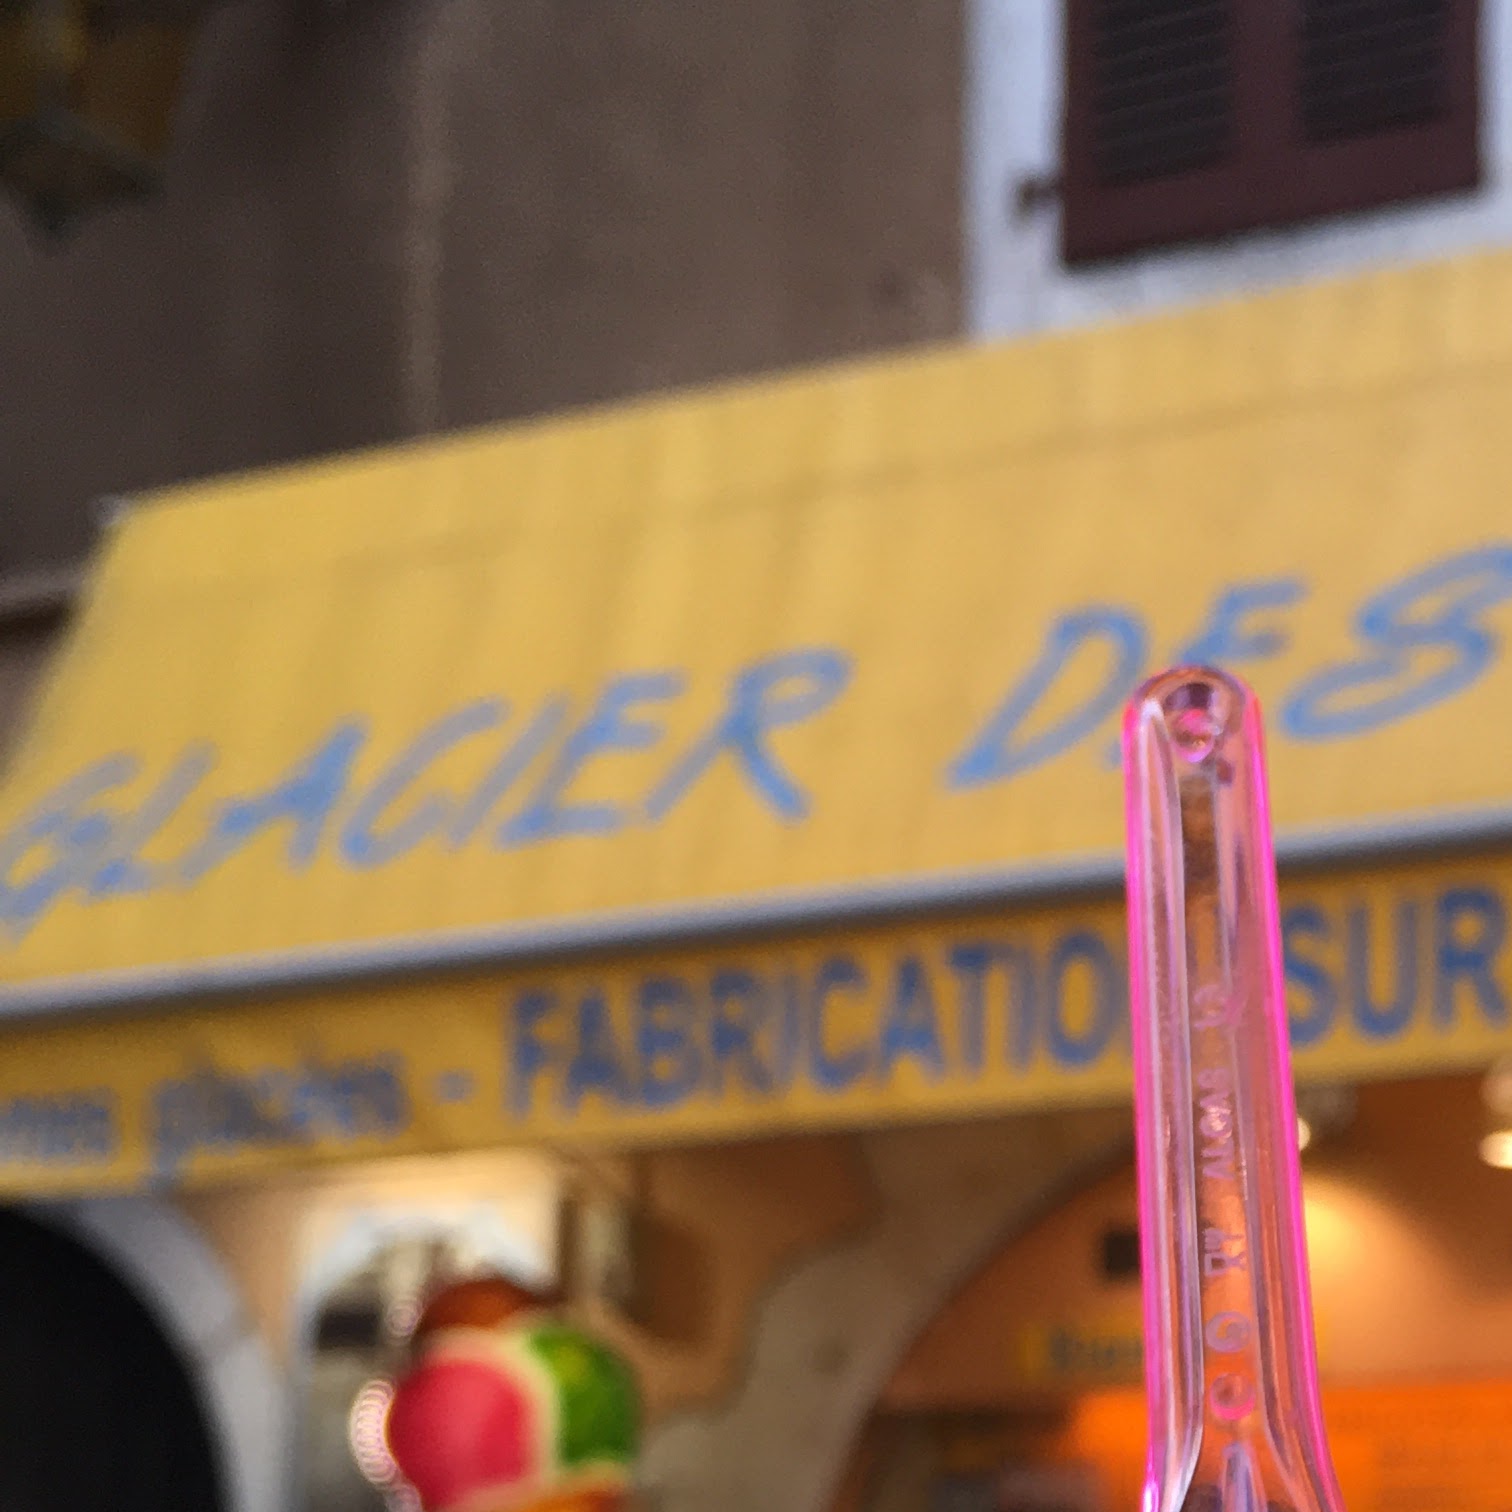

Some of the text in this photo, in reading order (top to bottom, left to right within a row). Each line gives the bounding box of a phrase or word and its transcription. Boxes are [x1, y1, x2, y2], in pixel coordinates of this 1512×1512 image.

[0, 646, 856, 945] GLACIER
[504, 924, 1130, 1124] FABRICATIO
[1280, 884, 1510, 1048] SUR
